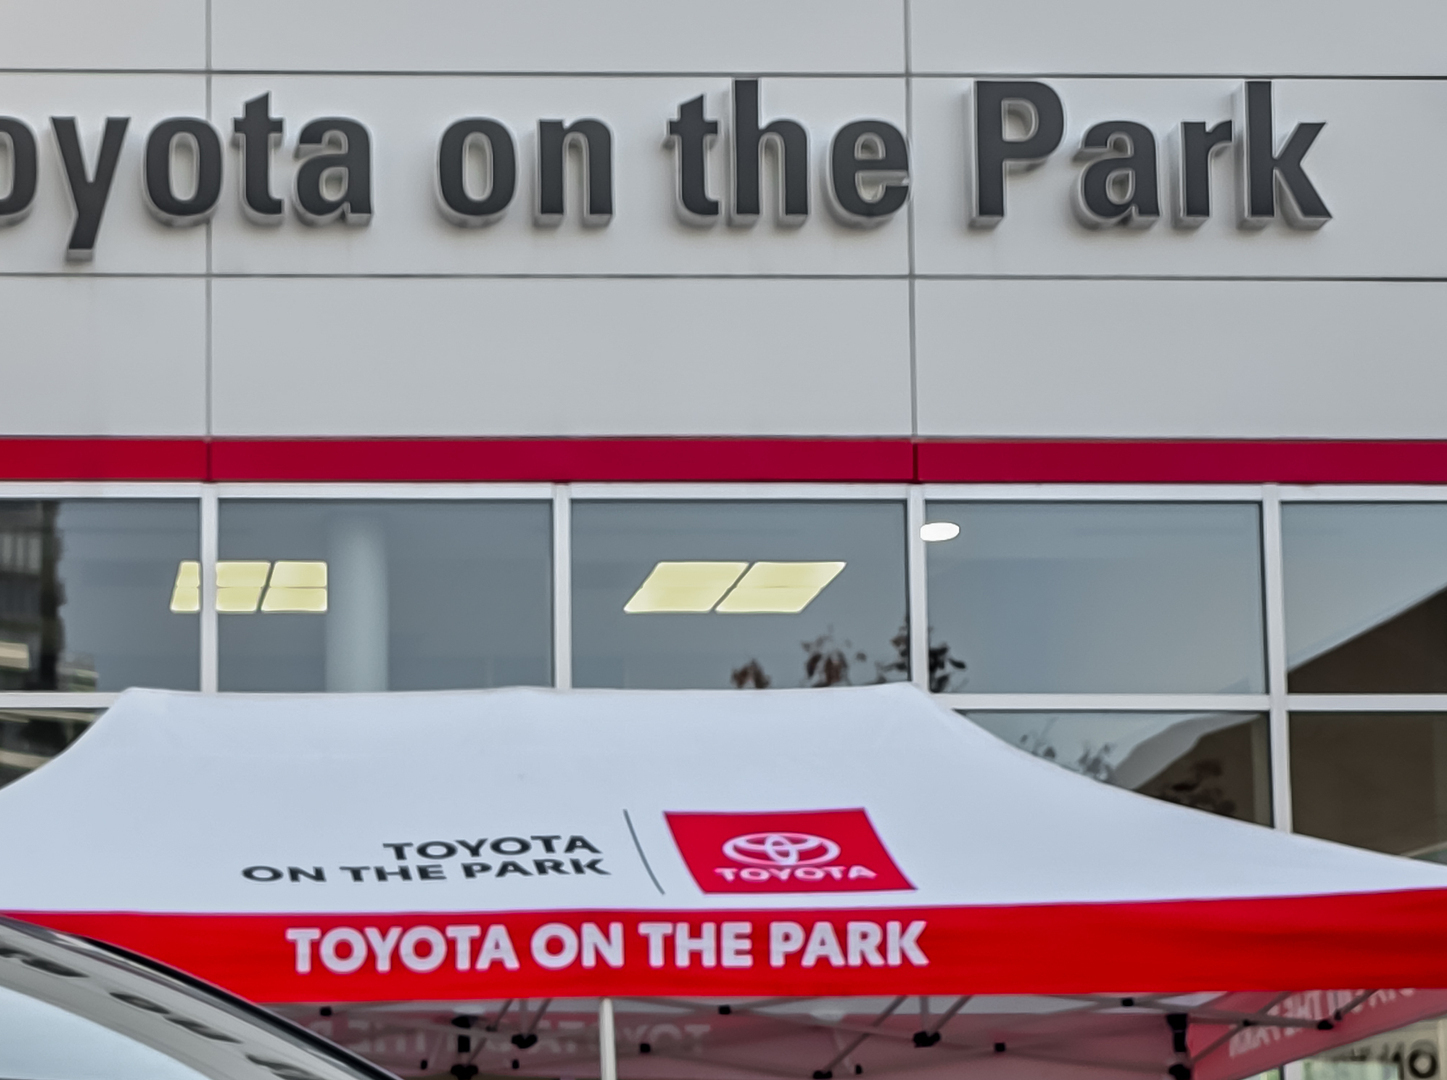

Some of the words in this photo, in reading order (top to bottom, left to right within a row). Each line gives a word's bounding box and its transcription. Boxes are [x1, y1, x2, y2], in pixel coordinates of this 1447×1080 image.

[435, 115, 615, 228] on
[665, 78, 912, 229] the
[968, 79, 1334, 231] Park
[382, 834, 603, 861] TOYOTA
[240, 865, 328, 883] ON
[338, 863, 448, 883] THE
[460, 857, 612, 880] PARK
[712, 864, 879, 883] TOYOTA
[286, 925, 520, 974] TOYOTA
[531, 922, 624, 970] ON
[638, 921, 753, 969] THE
[770, 920, 929, 968] PARK
